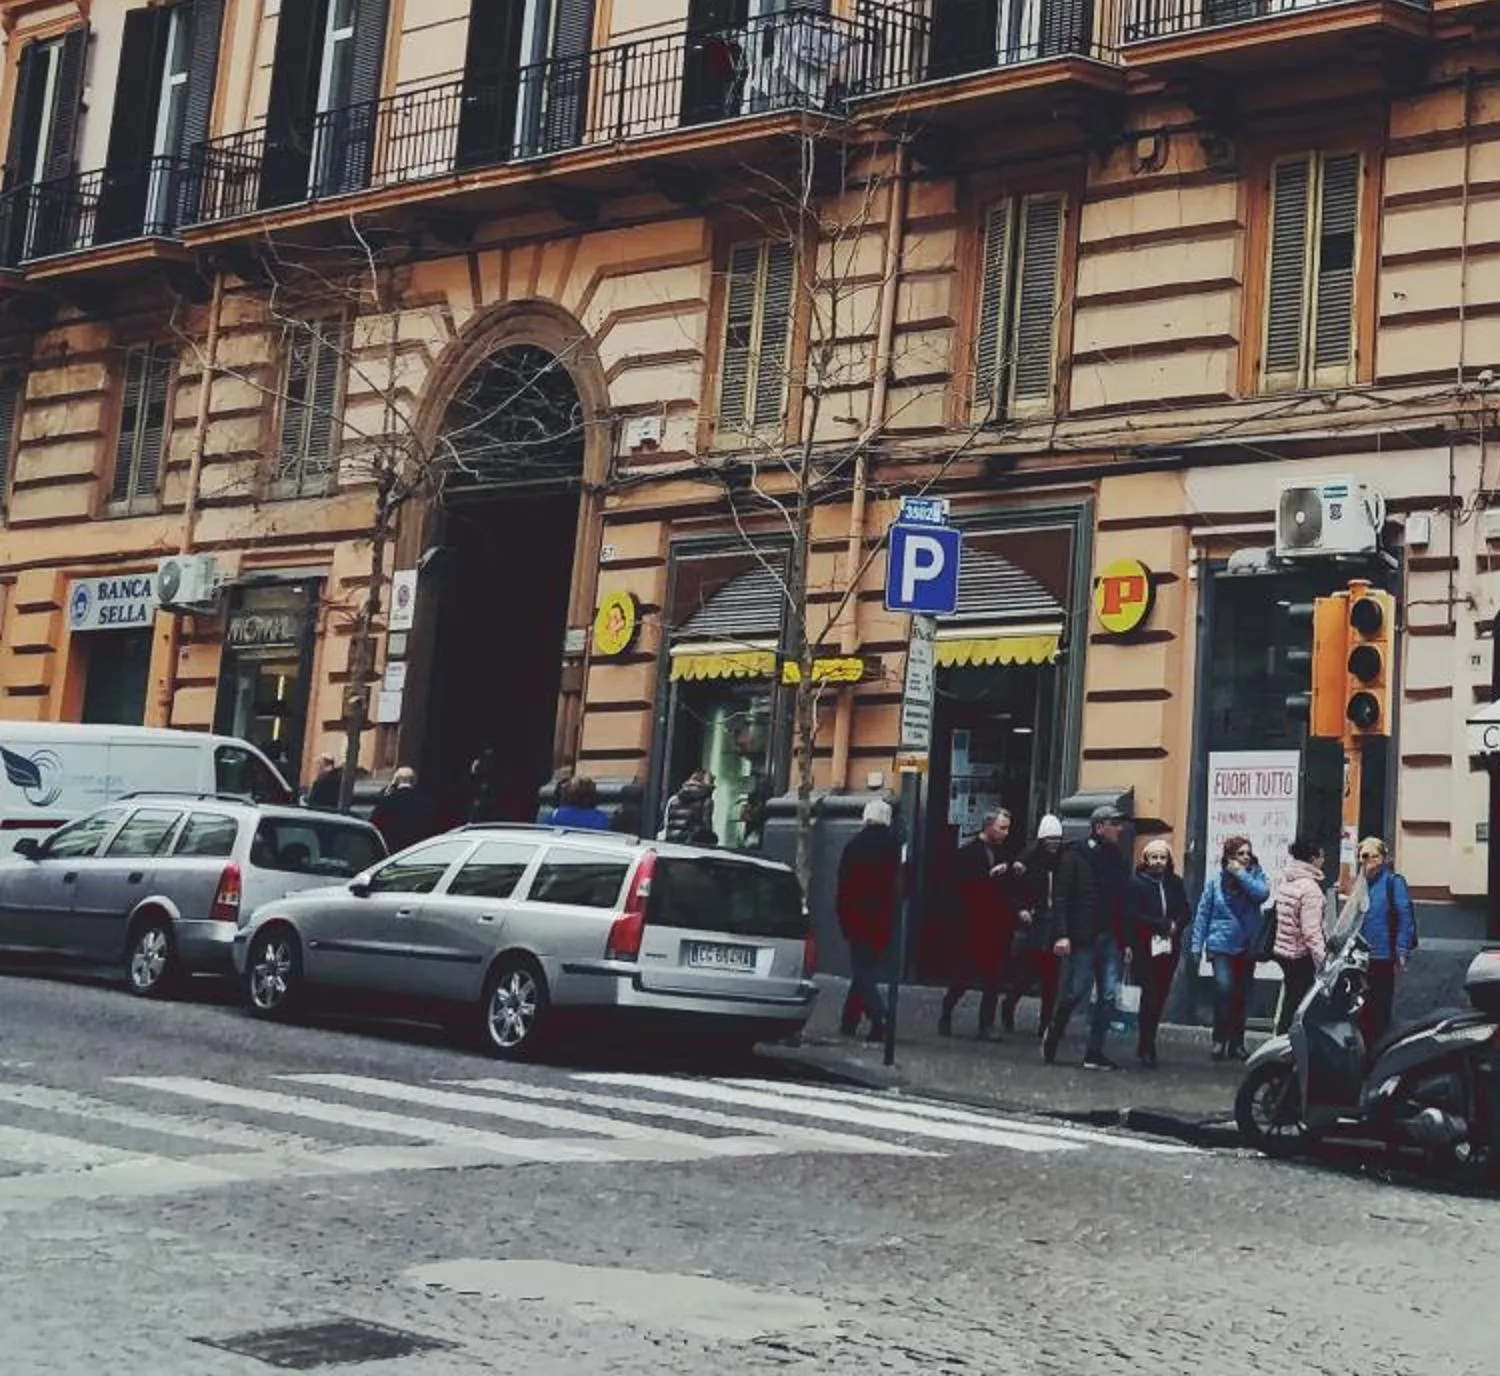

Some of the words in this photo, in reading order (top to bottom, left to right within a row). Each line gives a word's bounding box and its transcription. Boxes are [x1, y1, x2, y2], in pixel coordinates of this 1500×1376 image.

[901, 535, 946, 603] P
[98, 579, 152, 600] BANCA
[1101, 576, 1145, 616] P
[99, 603, 147, 624] SELLA
[1214, 771, 1251, 796] FUORI
[1255, 771, 1294, 795] TUTTO
